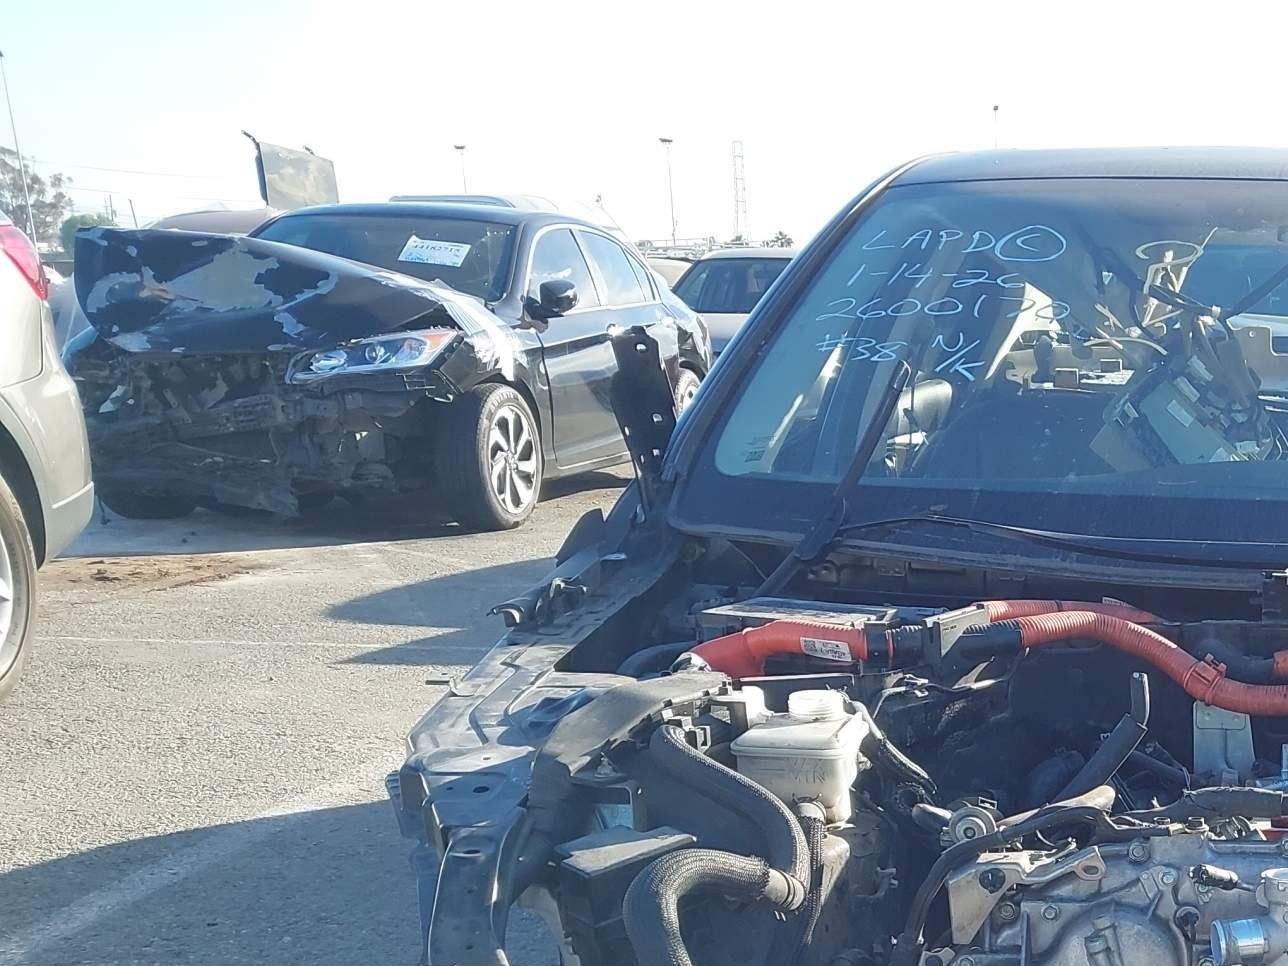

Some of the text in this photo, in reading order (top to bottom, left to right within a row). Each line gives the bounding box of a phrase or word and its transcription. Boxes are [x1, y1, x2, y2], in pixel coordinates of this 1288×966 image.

[862, 229, 995, 252] LAPD
[847, 263, 1026, 289] 1-14-26
[815, 294, 1071, 321] 2600170
[815, 331, 908, 362] #38
